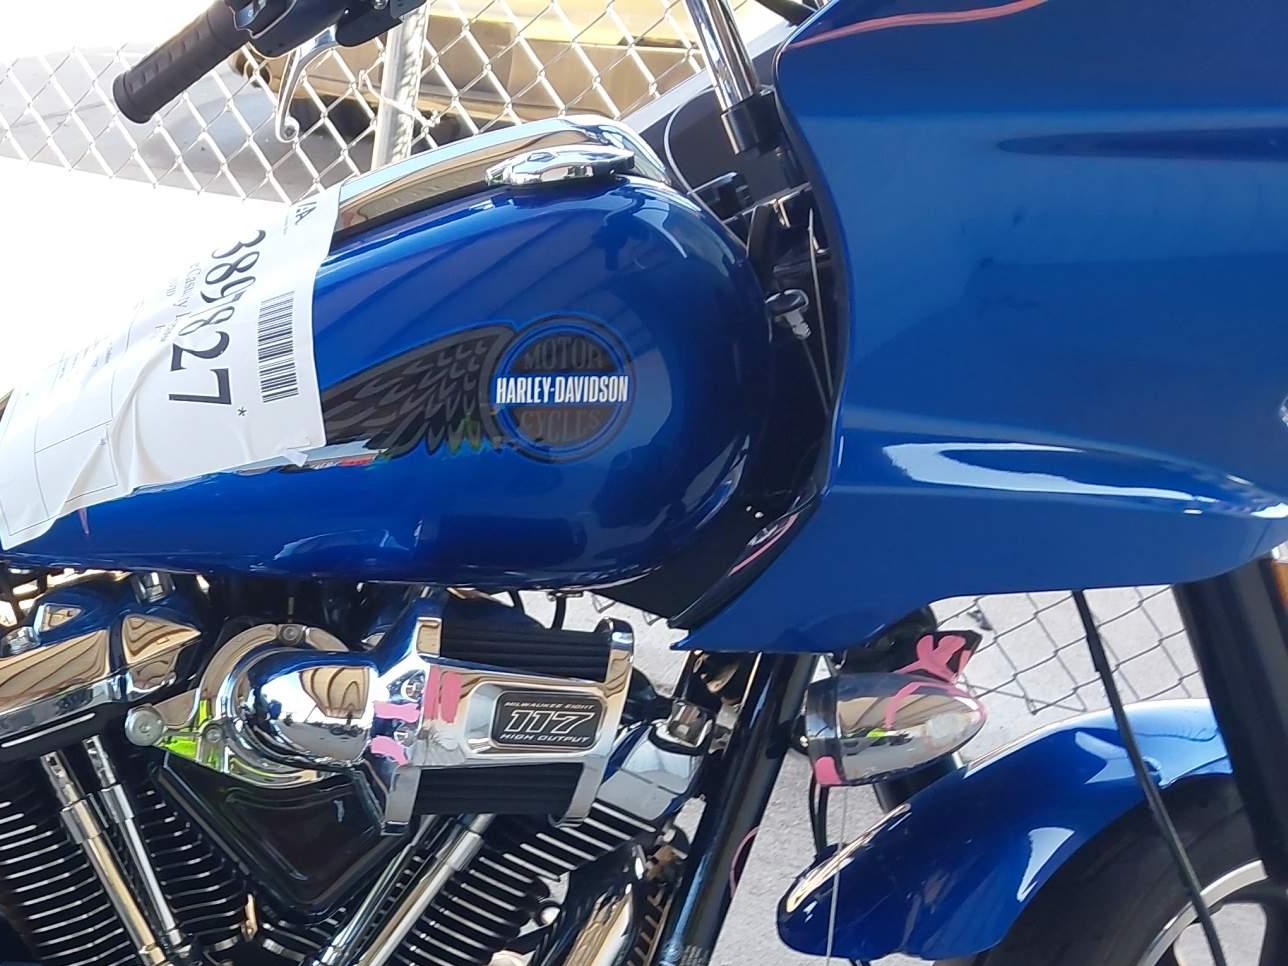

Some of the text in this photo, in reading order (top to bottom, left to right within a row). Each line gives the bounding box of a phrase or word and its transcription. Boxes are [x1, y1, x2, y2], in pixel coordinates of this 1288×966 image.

[522, 336, 604, 370] MOTOR
[496, 376, 629, 403] HARLEY-DAVIDSON
[504, 709, 595, 733] 117
